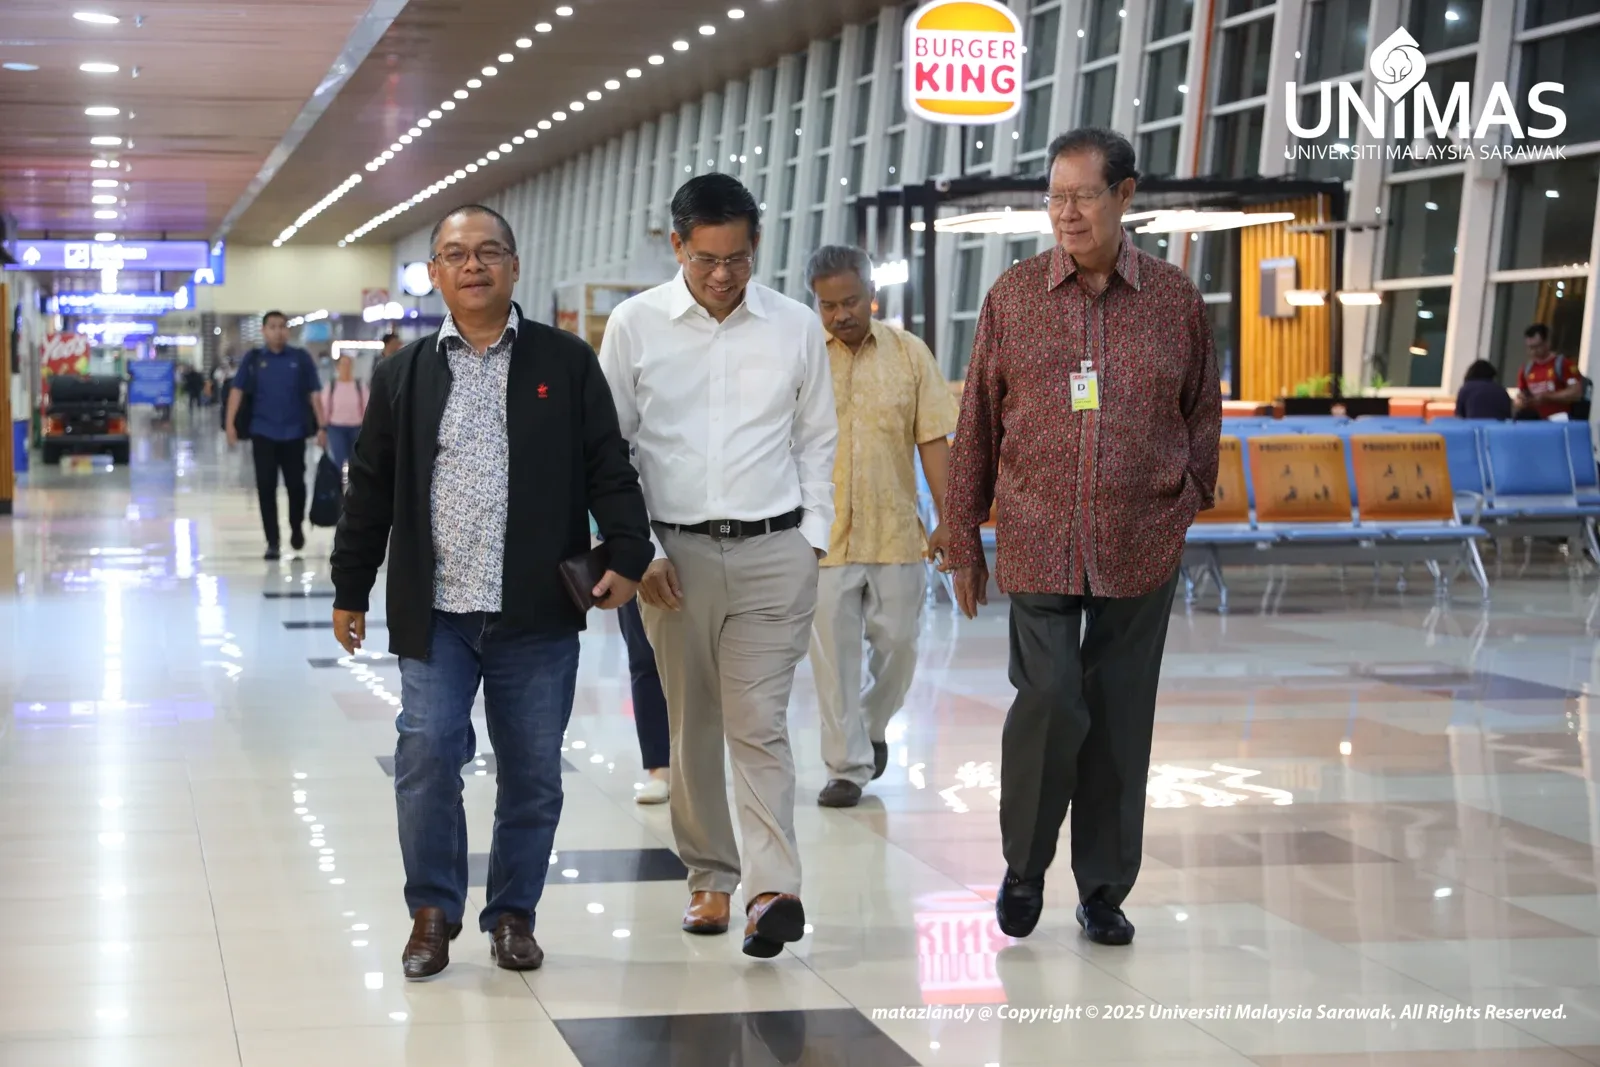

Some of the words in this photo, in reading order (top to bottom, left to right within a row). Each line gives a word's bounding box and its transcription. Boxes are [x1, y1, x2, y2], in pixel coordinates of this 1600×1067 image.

[915, 36, 1016, 60] BURGER
[915, 61, 1016, 95] KING
[1077, 383, 1086, 392] D
